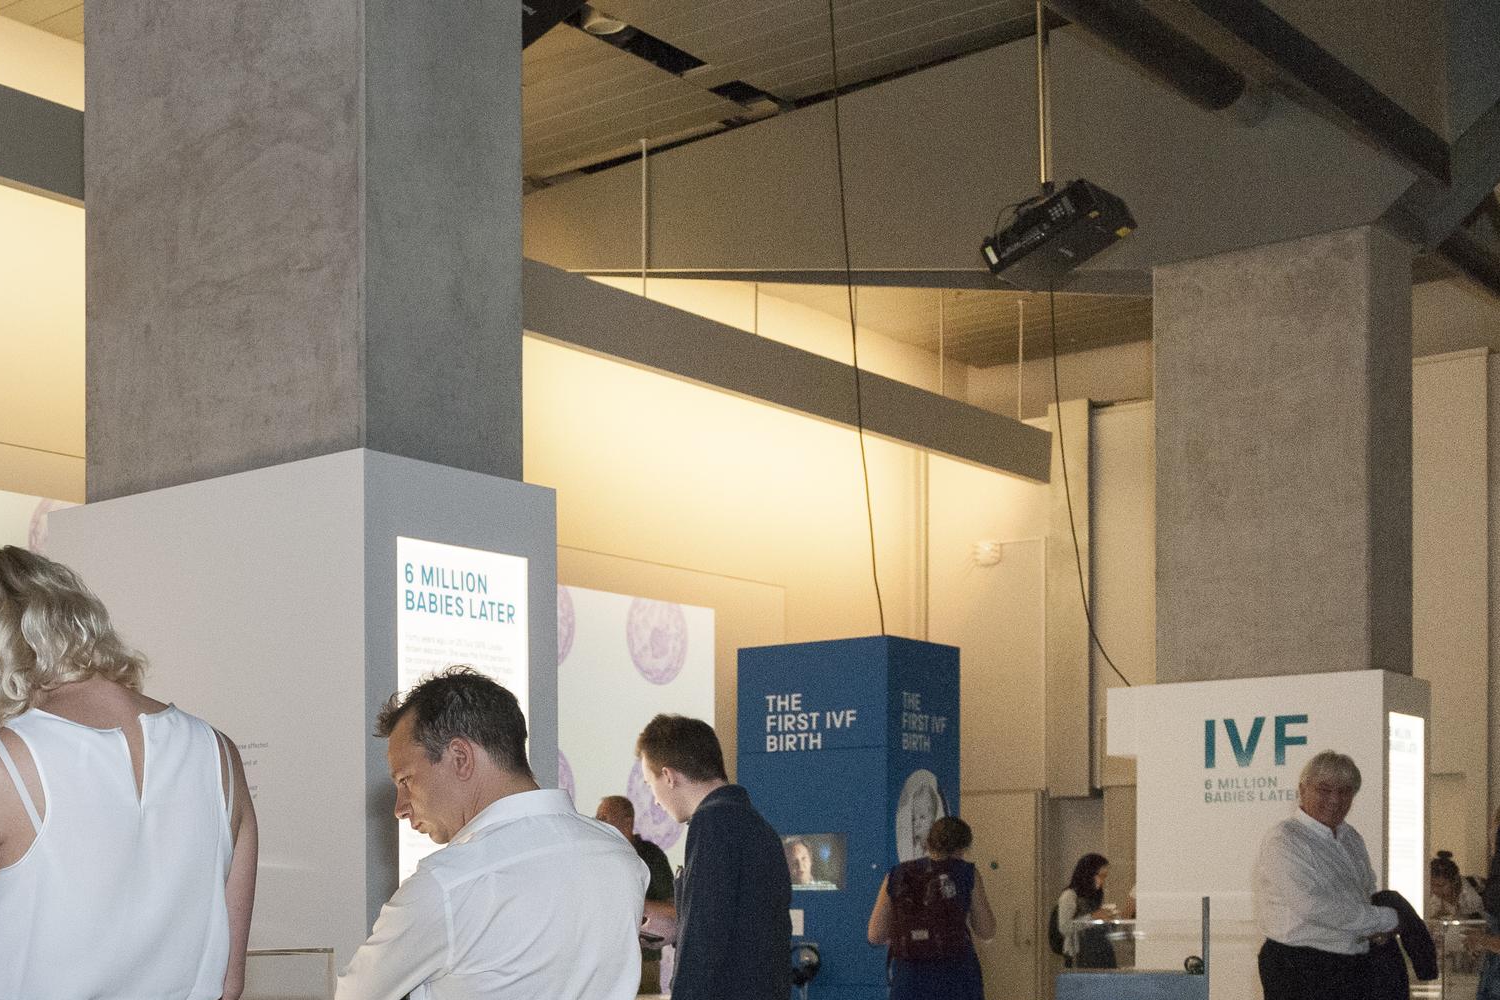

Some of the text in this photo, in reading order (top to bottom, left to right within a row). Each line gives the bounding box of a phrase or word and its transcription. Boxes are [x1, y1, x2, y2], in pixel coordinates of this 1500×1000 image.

[404, 562, 488, 595] 6 MILLION
[405, 589, 516, 625] BABIES LATER
[765, 693, 802, 712] THE
[902, 692, 921, 711] THE
[766, 709, 857, 732] FIRST IVF
[902, 712, 947, 733] FIRST IVF
[766, 733, 822, 752] BIRTH
[902, 733, 931, 752] BIRTH
[1204, 714, 1308, 769] IVF
[1204, 776, 1278, 790] 6 MILLION
[1205, 790, 1255, 803] BABIES
